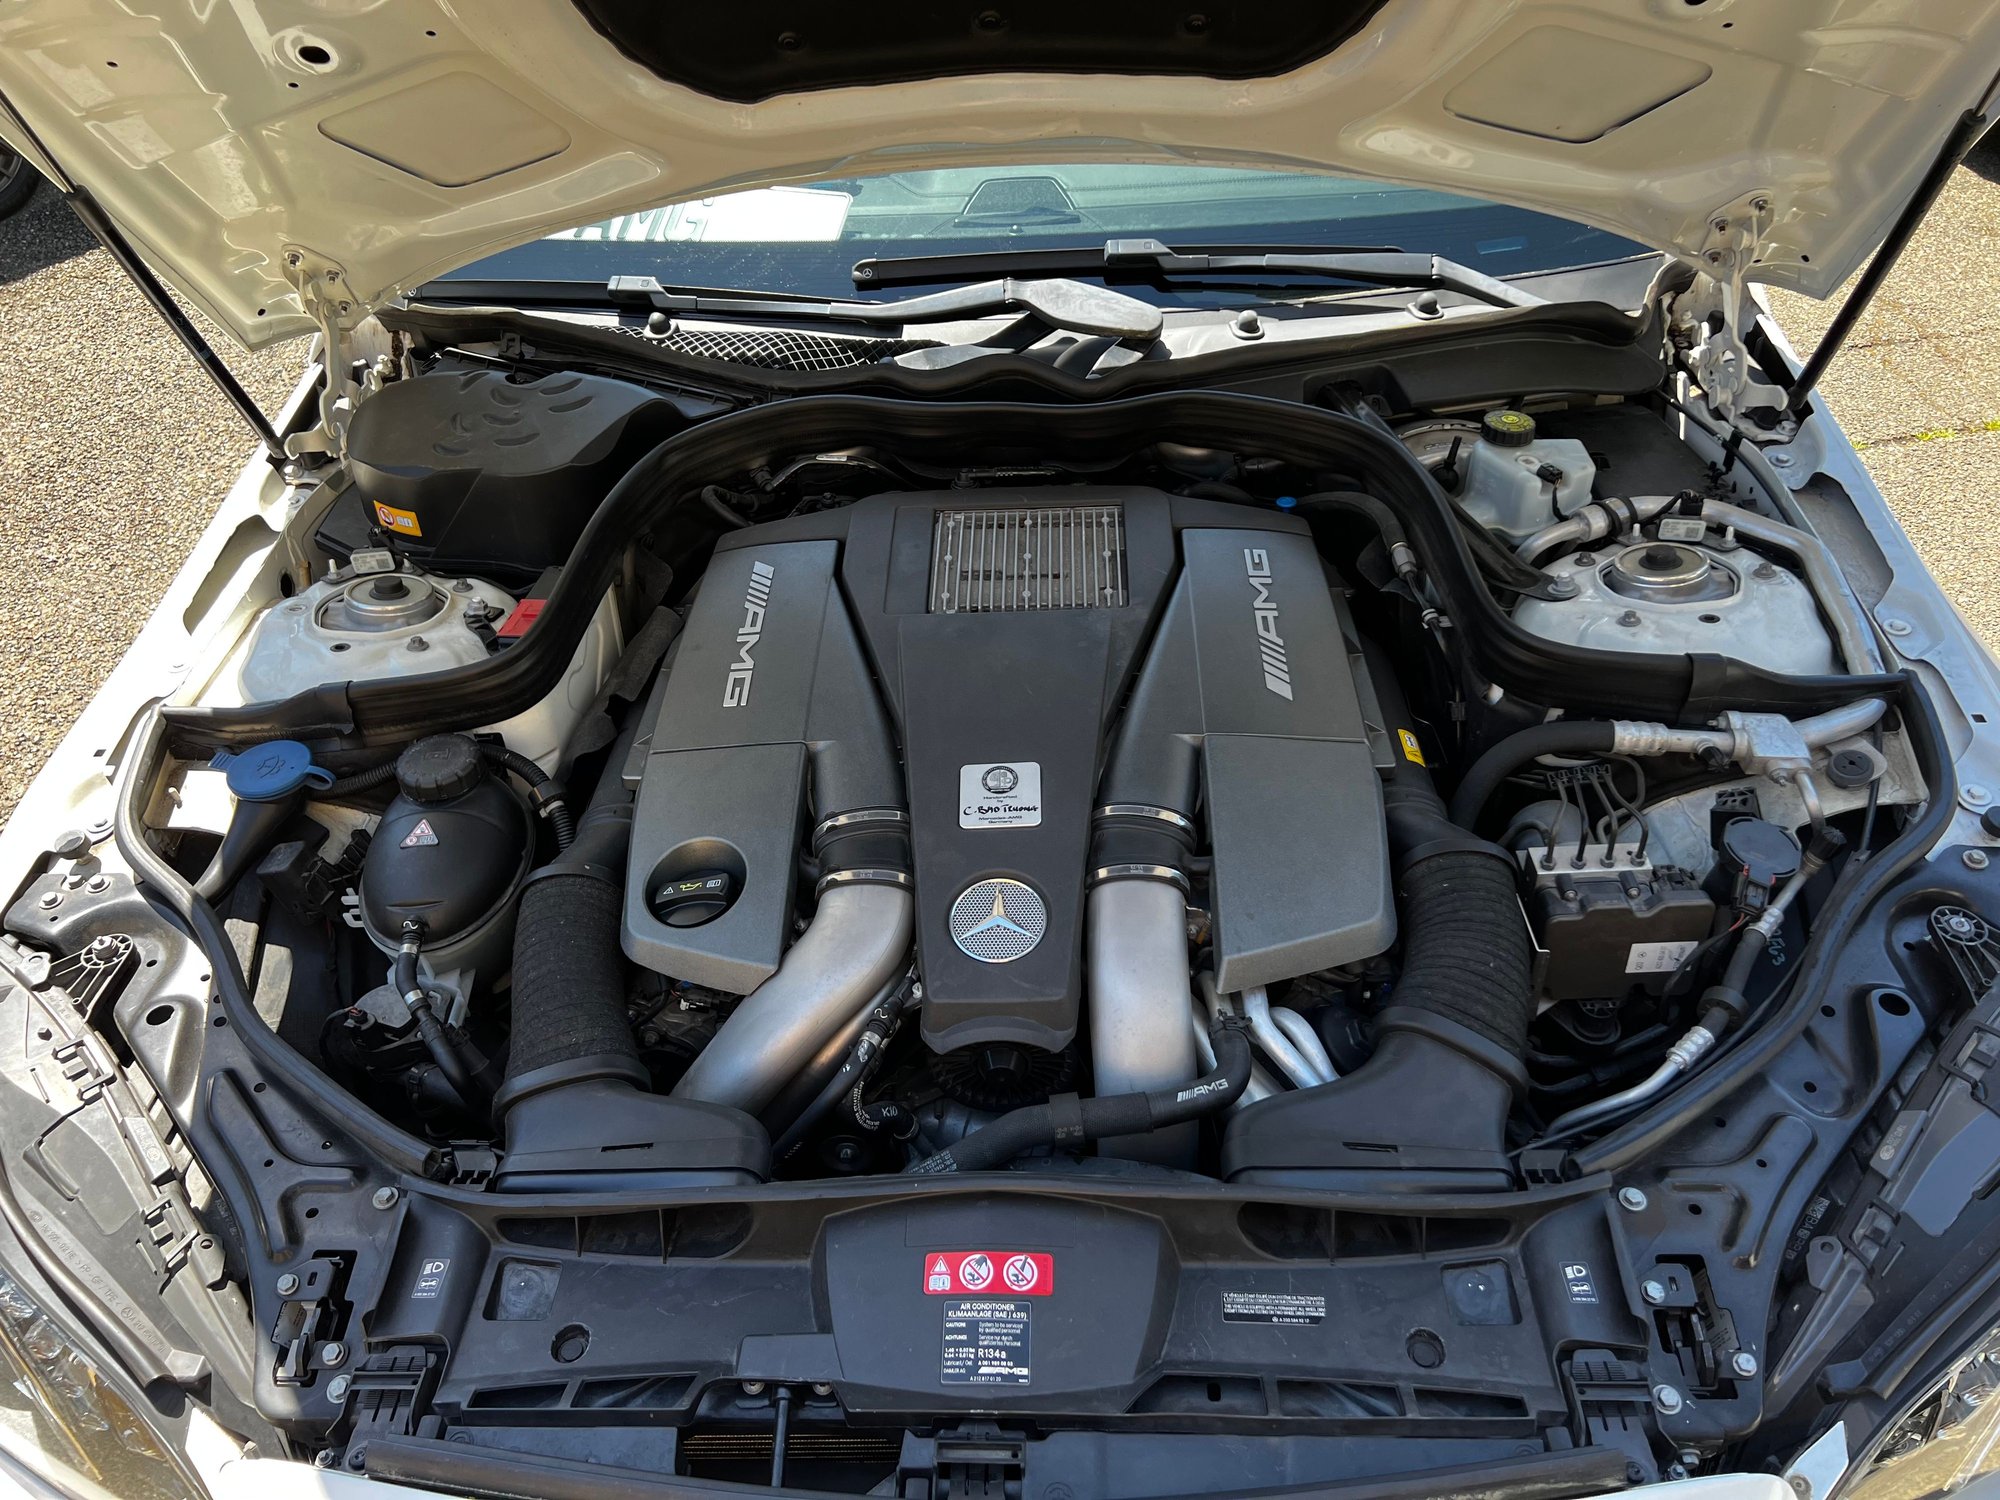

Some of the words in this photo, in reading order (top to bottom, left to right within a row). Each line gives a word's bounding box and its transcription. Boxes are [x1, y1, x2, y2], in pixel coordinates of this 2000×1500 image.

[1243, 548, 1284, 647] AMG
[722, 601, 766, 708] AMG
[1192, 1077, 1229, 1098] AMG
[993, 1311, 1007, 1319] (SAE
[1012, 1312, 1027, 1320] 639)
[978, 1348, 1006, 1359] R134a
